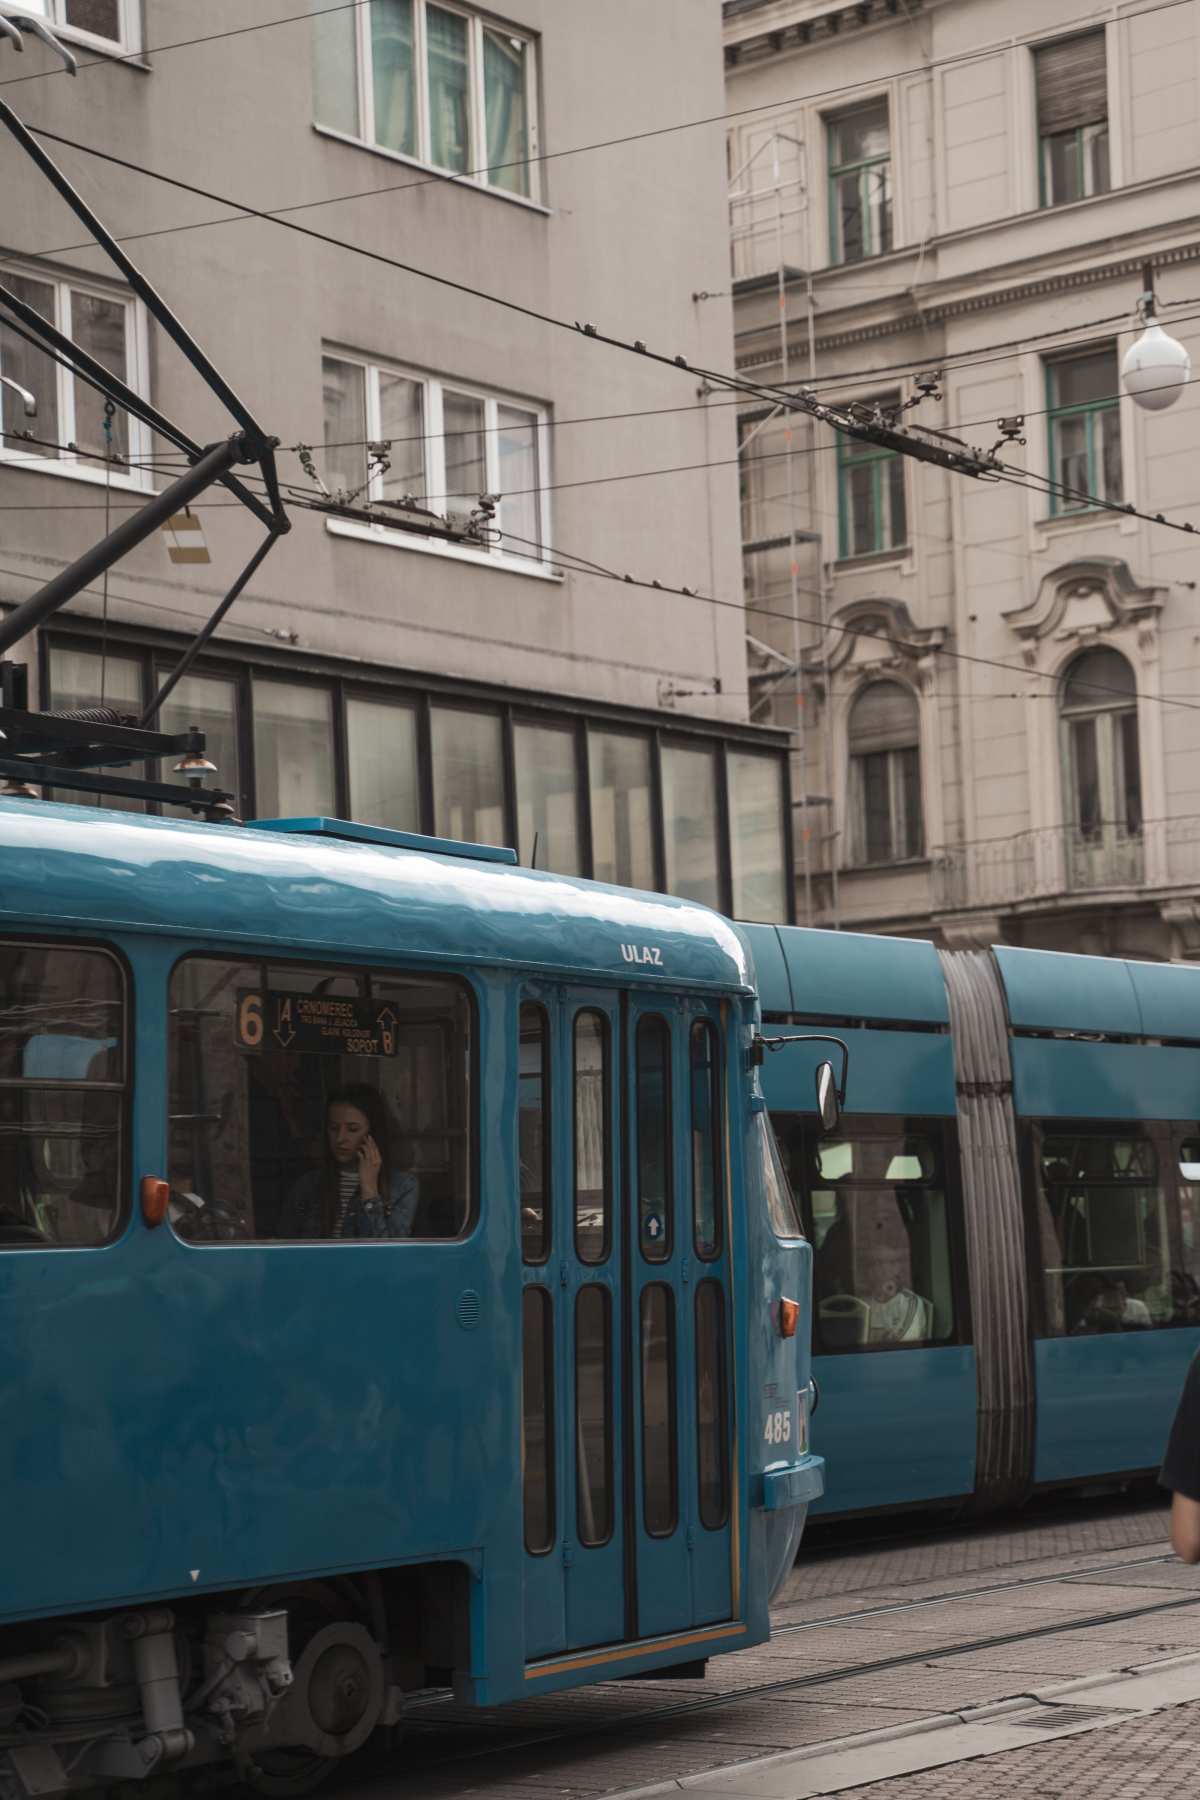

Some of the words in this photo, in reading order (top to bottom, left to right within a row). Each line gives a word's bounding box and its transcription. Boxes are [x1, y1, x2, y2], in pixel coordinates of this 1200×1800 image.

[620, 943, 664, 966] ULAZ
[240, 994, 263, 1045] 6
[281, 998, 291, 1021] A
[346, 1038, 378, 1053] SOPOT
[383, 1031, 392, 1054] B
[763, 1411, 791, 1445] 485
